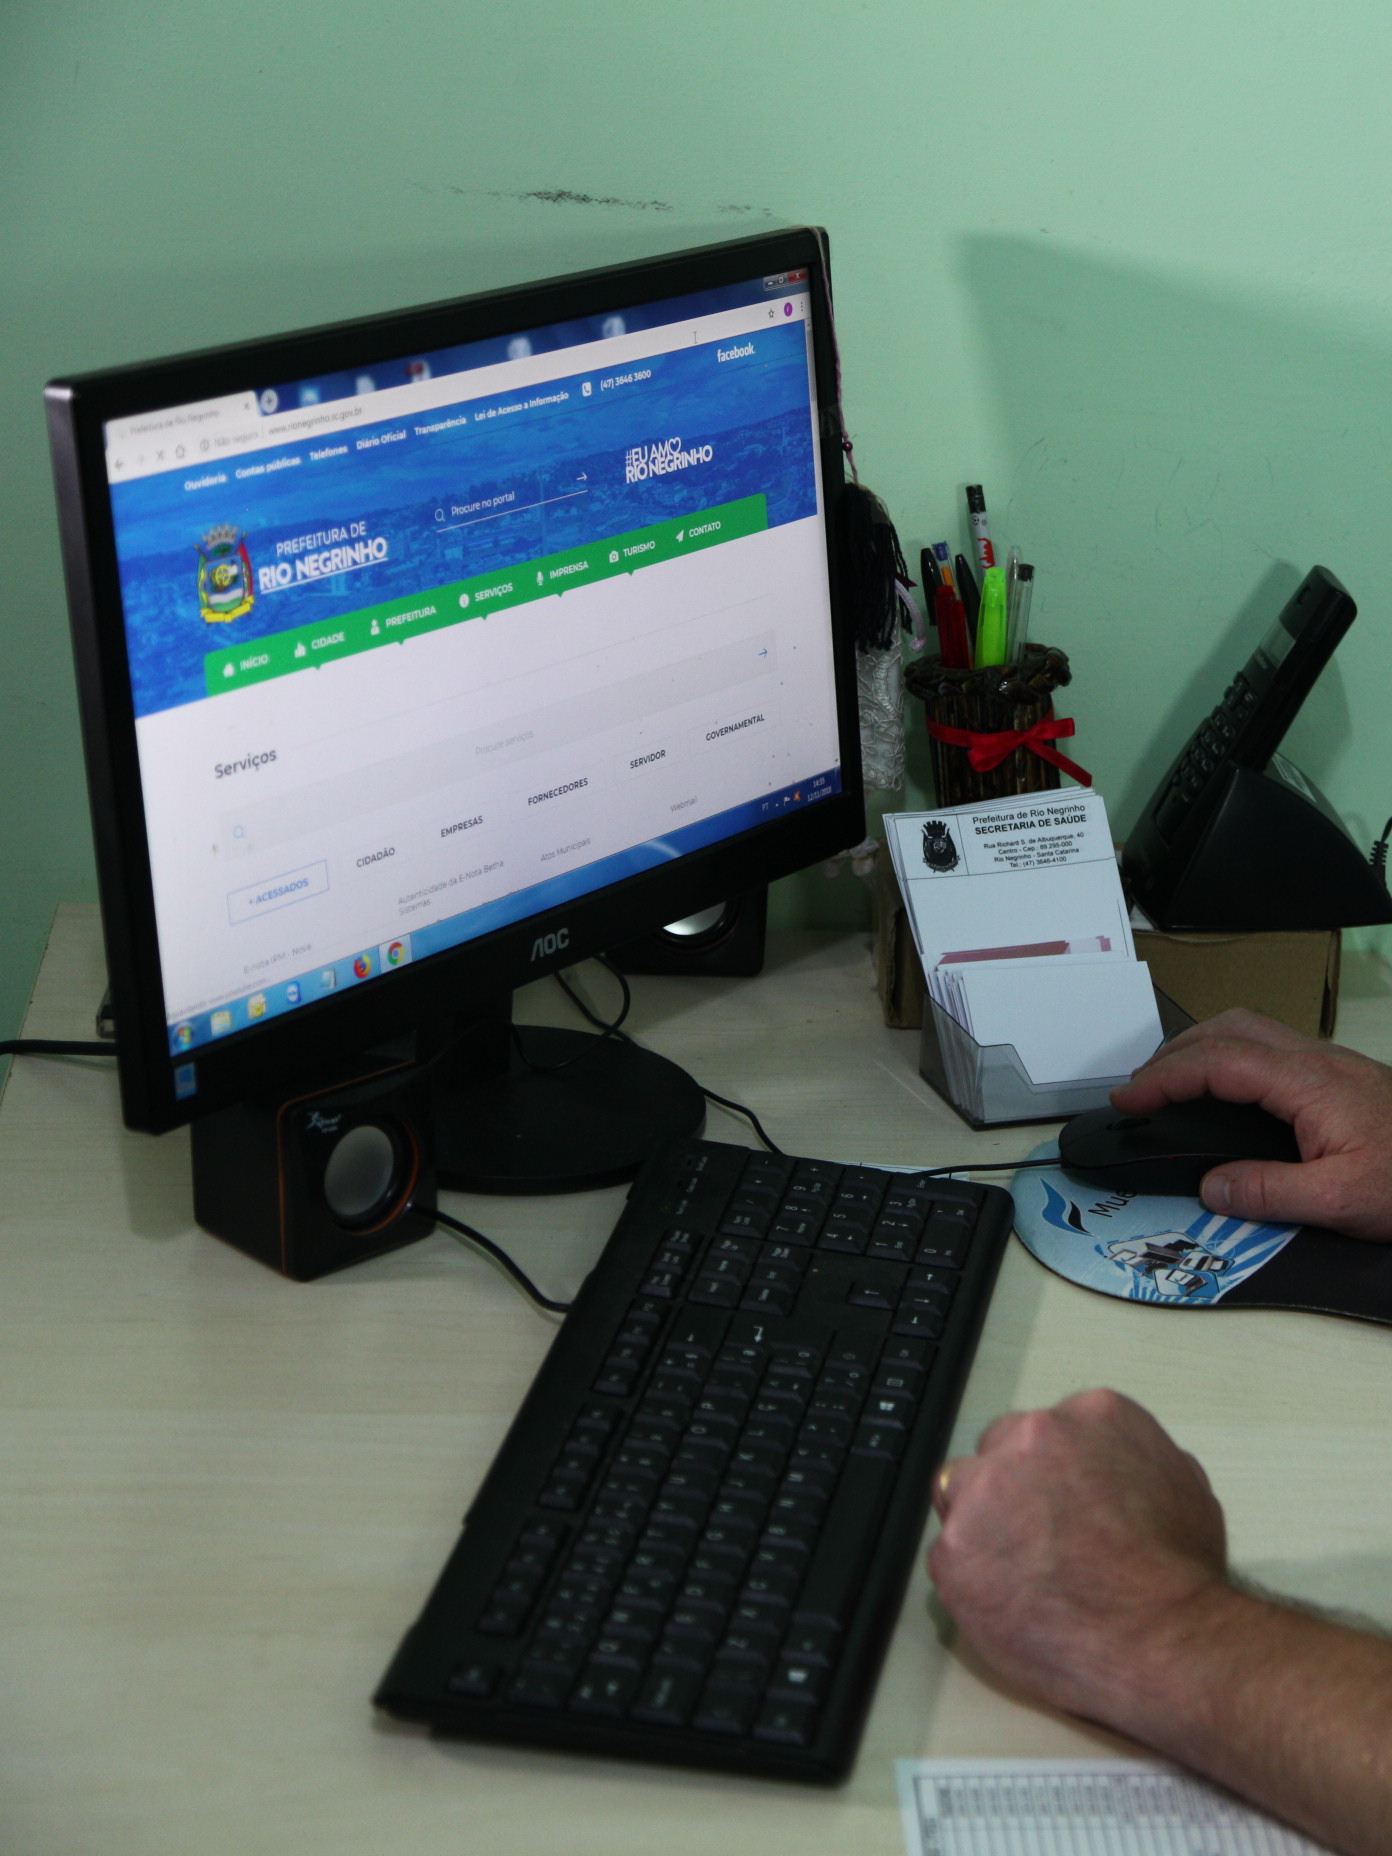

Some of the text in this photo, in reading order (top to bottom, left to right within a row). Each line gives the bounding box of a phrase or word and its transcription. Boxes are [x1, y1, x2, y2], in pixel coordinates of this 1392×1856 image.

[717, 343, 755, 363] facebook
[600, 368, 652, 392] (47) 3646 3600
[268, 407, 363, 436] www.rionegrinho.sc.gov.br
[184, 473, 228, 492] Ouvidoria
[235, 463, 265, 479] Contas
[266, 455, 301, 474] públicas
[309, 444, 348, 462] Telefones
[356, 434, 380, 451] Diário
[380, 429, 408, 446] Oficial
[414, 416, 467, 436] Transparência
[474, 410, 486, 422] Lei
[486, 407, 497, 420] de
[497, 401, 523, 417] Acesso
[529, 391, 570, 409] Informação
[626, 444, 713, 484] RIO NEGRINHO
[451, 490, 515, 517] Procure no portal
[276, 520, 367, 557] PREFEITURA DE
[258, 536, 388, 591] RIO NEGRINHO
[239, 520, 722, 671] INÍCIO CIDADE PREFEITURA SERVIÇOS IMPRENSA TURISMO CONTATO
[213, 747, 278, 780] Serviços
[255, 714, 766, 905] ACESSADOS CIDADÃO EMPRESAS FORNECEDORES SERVIDOR GOVERNAMENTAL
[972, 804, 1086, 825] Prefeitura de Rio Negrinho
[974, 813, 1087, 836] SECRETARIA DE SAÚDE
[556, 837, 592, 859] Municipais
[996, 840, 1020, 848] Richard
[1005, 854, 1032, 863] Negrinho
[1036, 850, 1054, 858] Santa
[1054, 847, 1080, 856] Catarina
[1022, 860, 1035, 868] (47)
[530, 927, 570, 962] AOC
